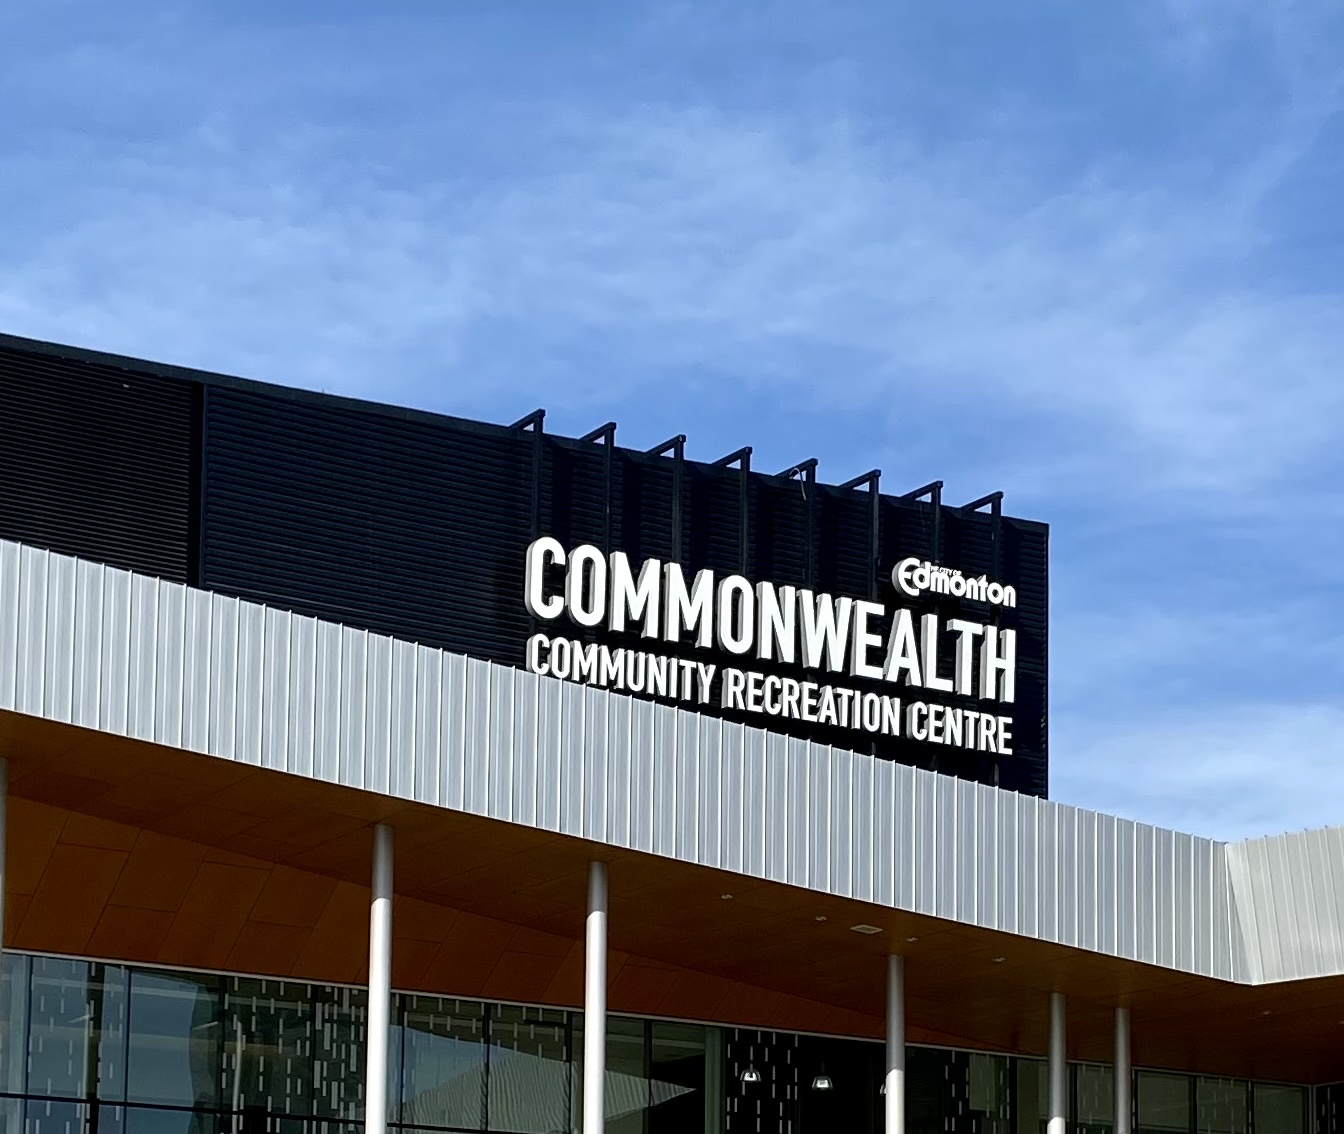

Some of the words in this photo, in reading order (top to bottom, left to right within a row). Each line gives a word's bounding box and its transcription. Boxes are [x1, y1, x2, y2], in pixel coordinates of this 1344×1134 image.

[525, 536, 1016, 704] COMMONWEALTH
[892, 557, 1016, 608] Edmonton
[526, 633, 716, 705] COMMUNITY
[722, 667, 901, 737] RECREATION
[906, 701, 1013, 756] CENTRE
